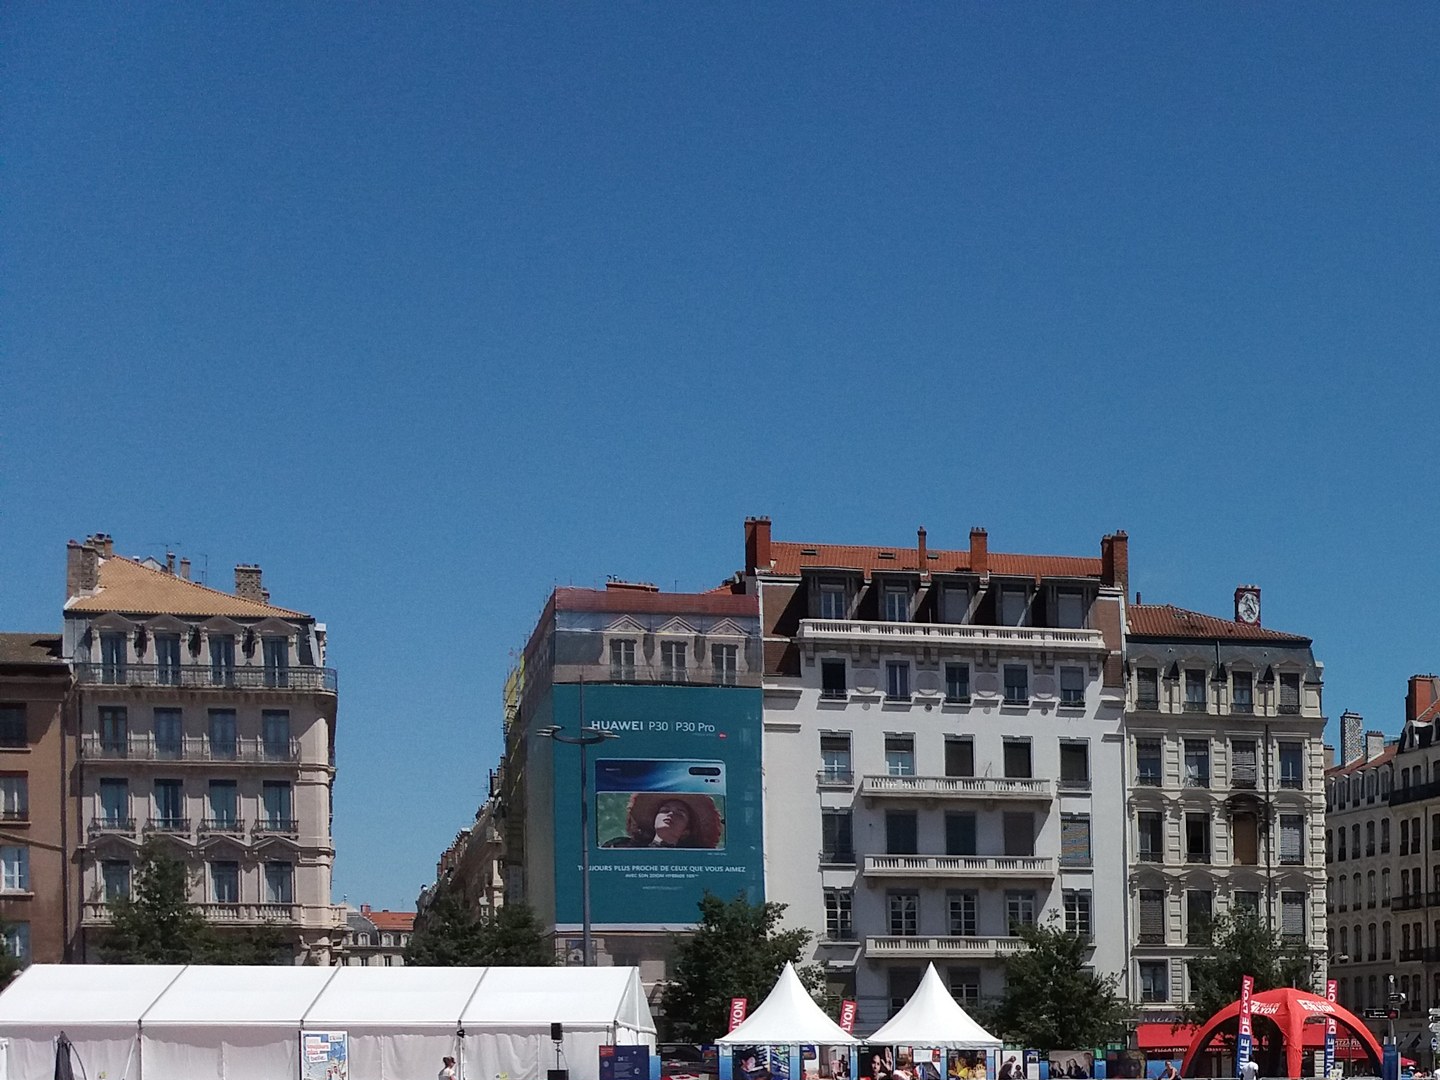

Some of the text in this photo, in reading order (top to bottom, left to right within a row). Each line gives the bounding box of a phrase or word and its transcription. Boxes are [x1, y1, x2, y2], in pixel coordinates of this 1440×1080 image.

[591, 720, 715, 732] HUAWEI P30 P30 Pro
[1242, 979, 1251, 1013] LYON
[732, 1000, 745, 1030] LYON
[842, 1003, 854, 1032] LYON
[1241, 1017, 1251, 1035] DE
[1326, 1038, 1335, 1073] VILLE
